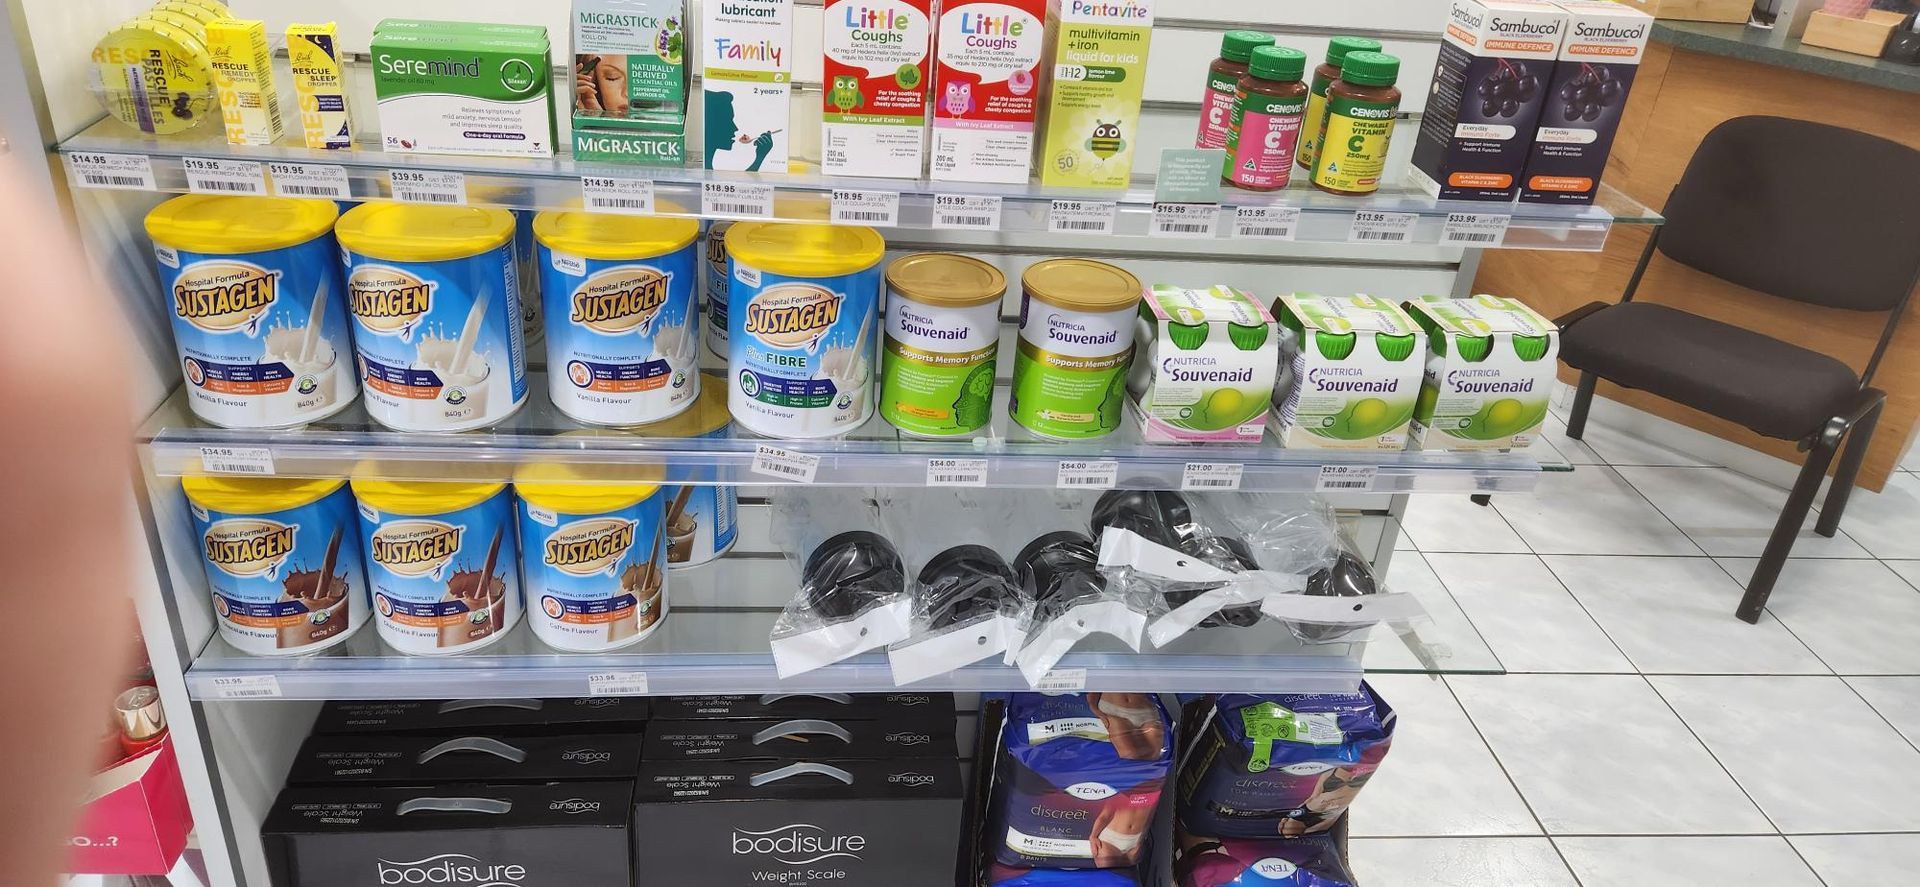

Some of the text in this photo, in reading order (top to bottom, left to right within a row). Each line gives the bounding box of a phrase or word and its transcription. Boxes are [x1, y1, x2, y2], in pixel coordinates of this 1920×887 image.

[722, 3, 775, 17] lubricant
[1072, 1, 1147, 18] Pentavite
[1451, 3, 1484, 29] Sambucol
[581, 12, 658, 28] MiGRASTICK
[846, 7, 908, 29] Little
[962, 13, 1023, 37] Little
[1490, 17, 1560, 35] Sambucol
[1574, 22, 1646, 39] Sambucol
[852, 29, 903, 43] Coughs
[1069, 29, 1140, 41] multivitamin
[967, 36, 1017, 50] Coughs
[1486, 41, 1552, 51] IMMUNE DEFENCE
[714, 38, 781, 67] Family
[1066, 50, 1139, 64] liquid for kids
[1570, 45, 1636, 56] IMMUNE DEFENCE
[379, 54, 479, 78] Seremind
[632, 63, 675, 73] NATURALLY
[1065, 67, 1080, 79] 1-12
[149, 50, 171, 107] RESCUE
[632, 71, 667, 80] DERIVED
[760, 88, 783, 96] years+
[1210, 107, 1223, 124] C
[1266, 104, 1302, 113] CENOVIS
[1350, 107, 1389, 118] CENOVIS
[1352, 128, 1386, 136] VITAMIN
[578, 137, 678, 156] MiGRASTICK
[1264, 131, 1281, 149] C
[1348, 135, 1365, 152] C
[72, 155, 106, 164] $14.95
[1058, 156, 1073, 170] 50
[1346, 152, 1370, 160] 250mg
[185, 160, 219, 170] $19.95
[271, 165, 304, 174] $19.95
[392, 172, 424, 181] $39.95
[584, 179, 614, 187] $14.95
[1241, 174, 1254, 183] 150
[1324, 176, 1336, 186] 150
[705, 184, 735, 192] $18.95
[833, 192, 862, 200] $18.95
[937, 196, 966, 205] $19.95
[1053, 202, 1081, 210] $19.95
[1157, 205, 1185, 213] $15.95
[185, 271, 250, 288] Hospital Formula
[589, 275, 650, 294] Hospital Formula
[174, 274, 275, 317] SUSTAGEN
[351, 284, 430, 317] SUSTAGEN
[572, 275, 668, 322] SUSTAGEN
[762, 293, 821, 307] Hospital Formula
[746, 295, 840, 334] SUSTAGEN
[902, 311, 933, 325] NUTRICIA
[901, 319, 968, 340] Souvenaid
[1050, 319, 1085, 331] NUTRICIA
[1049, 328, 1117, 345] Souvenaid
[766, 353, 806, 368] FIBRE
[899, 347, 934, 362] Supports
[935, 355, 970, 365] Memory
[1046, 355, 1115, 368] Supports Memory
[1171, 368, 1253, 382] Souvenaid
[1320, 367, 1363, 376] NUTRICIA
[1458, 369, 1500, 377] NUTRICIA
[1316, 378, 1398, 393] Souvenaid
[1454, 378, 1533, 393] Souvenaid
[576, 393, 601, 404] Vanilla
[445, 410, 462, 418] 840g
[746, 401, 794, 419] Vanilla Flavour
[201, 447, 233, 457] $34.95
[929, 460, 956, 468] $54.00
[1060, 462, 1087, 470] $54.00
[214, 527, 270, 540] Hospital Formula
[383, 527, 439, 540] Hospital Formula
[560, 524, 617, 542] Hospital Formula
[205, 527, 293, 563] SUSTAGEN
[372, 528, 459, 564] SUSTAGEN
[545, 522, 635, 565] SUSTAGEN
[550, 622, 570, 632] Coffee
[1284, 694, 1323, 703] discreet
[1045, 724, 1055, 733] M
[1075, 787, 1107, 795] TENA
[1031, 805, 1088, 820] discreet
[1040, 826, 1073, 834] BLANC
[732, 831, 866, 854] bodisure
[377, 860, 526, 885] bodisure
[1261, 864, 1290, 872] TENA
[752, 869, 846, 883] Weight Scale
